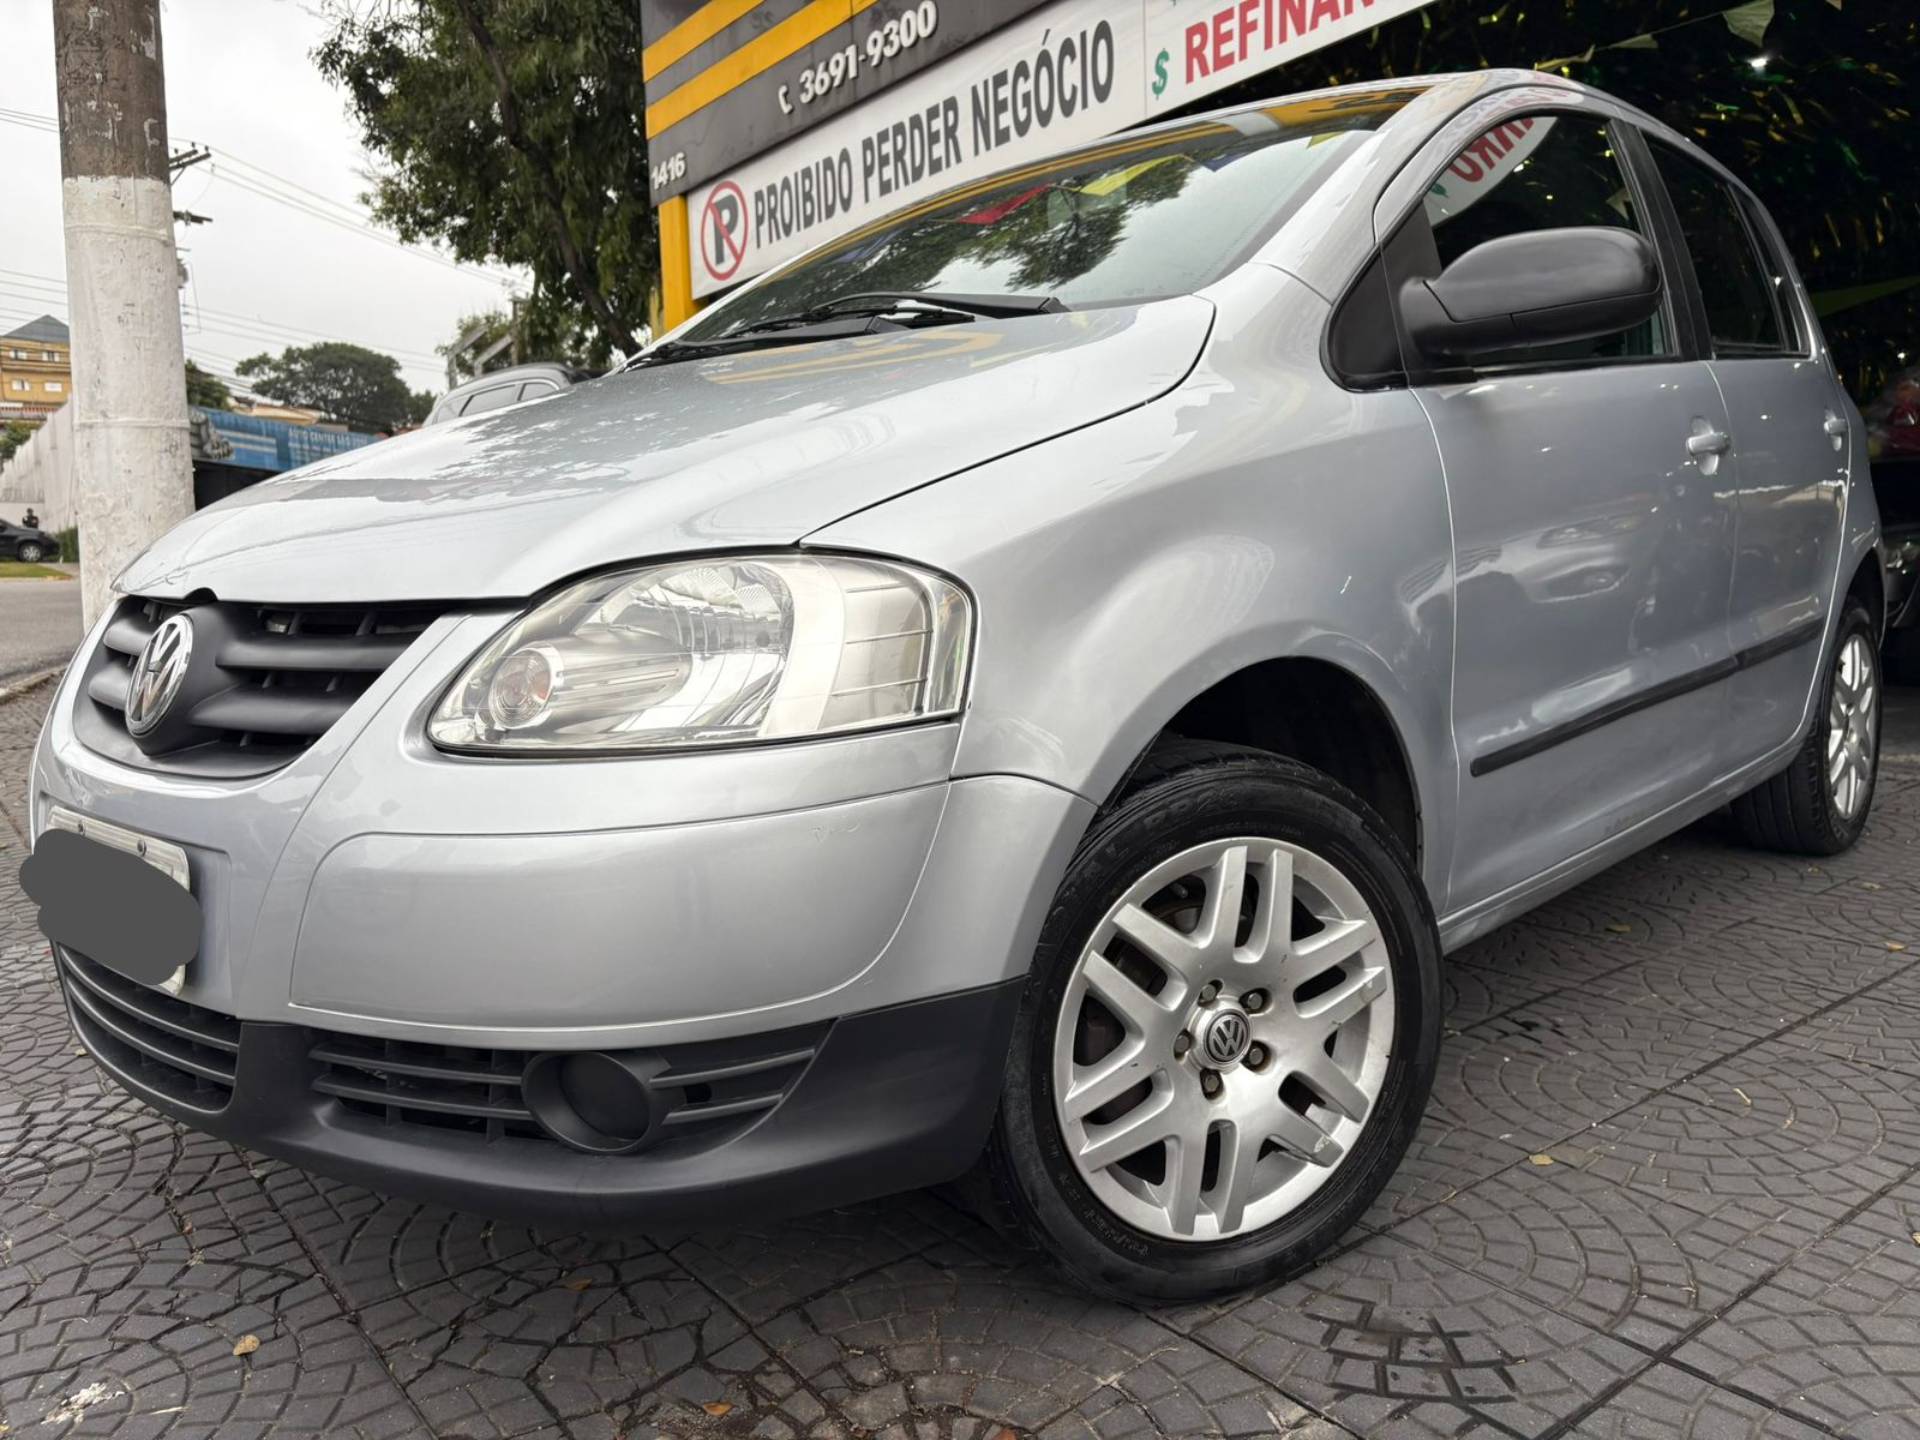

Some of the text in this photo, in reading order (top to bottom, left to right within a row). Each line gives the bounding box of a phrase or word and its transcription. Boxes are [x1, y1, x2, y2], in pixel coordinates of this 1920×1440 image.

[800, 0, 938, 104] 3691-9300
[651, 151, 686, 190] 1416
[754, 147, 853, 249] PROIBIDO
[862, 96, 962, 204] PERDER
[972, 20, 1114, 156] NEGÓCIO
